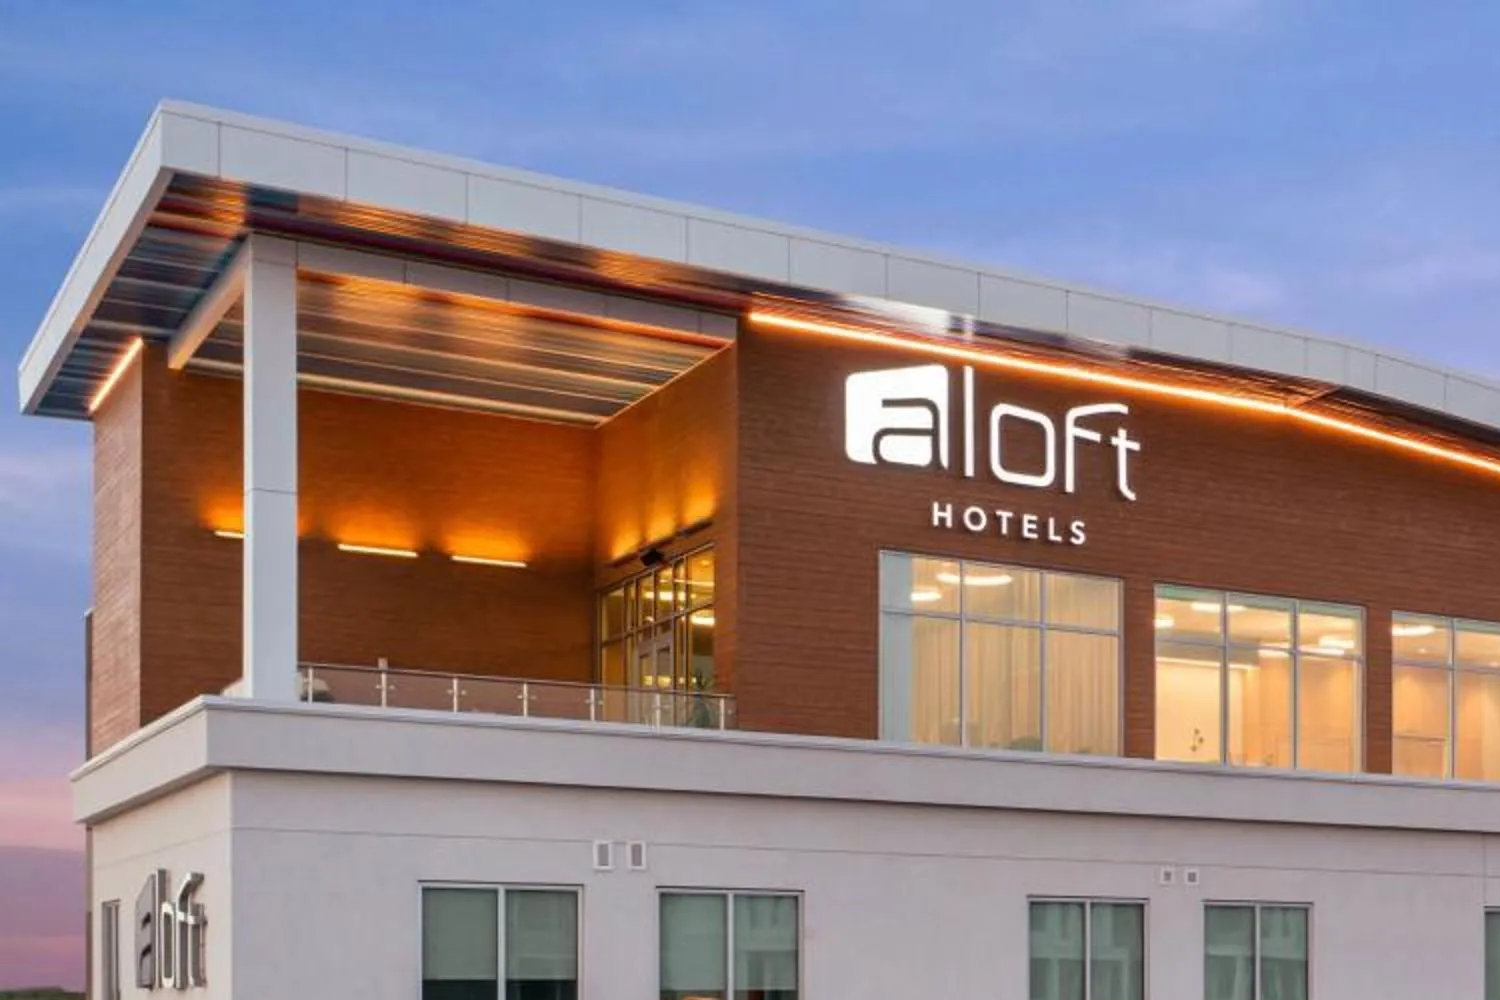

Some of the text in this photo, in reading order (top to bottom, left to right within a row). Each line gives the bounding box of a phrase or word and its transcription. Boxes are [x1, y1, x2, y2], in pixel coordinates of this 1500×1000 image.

[845, 363, 1141, 501] aloft
[932, 502, 1086, 545] HOTELS
[134, 868, 208, 990] aloft
